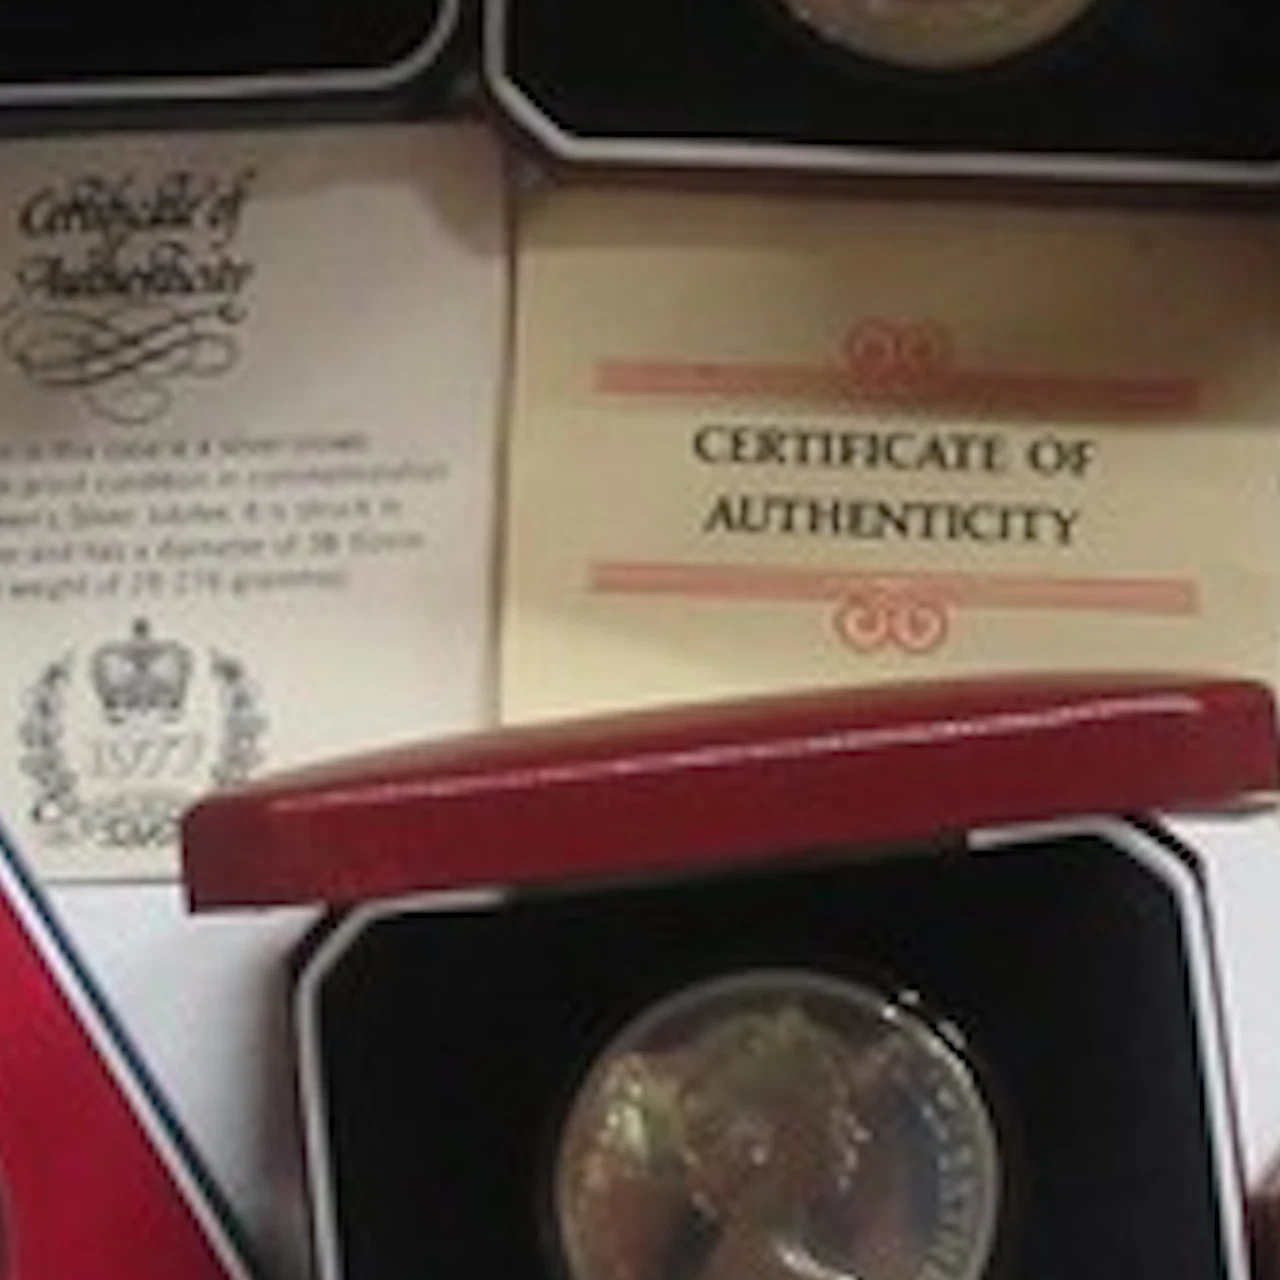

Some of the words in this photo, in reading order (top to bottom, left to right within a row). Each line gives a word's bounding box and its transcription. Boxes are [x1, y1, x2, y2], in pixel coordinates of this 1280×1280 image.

[693, 424, 1007, 473] CERTIFICATE
[1024, 433, 1098, 478] OF
[702, 493, 1082, 548] AUTHENTICITY
